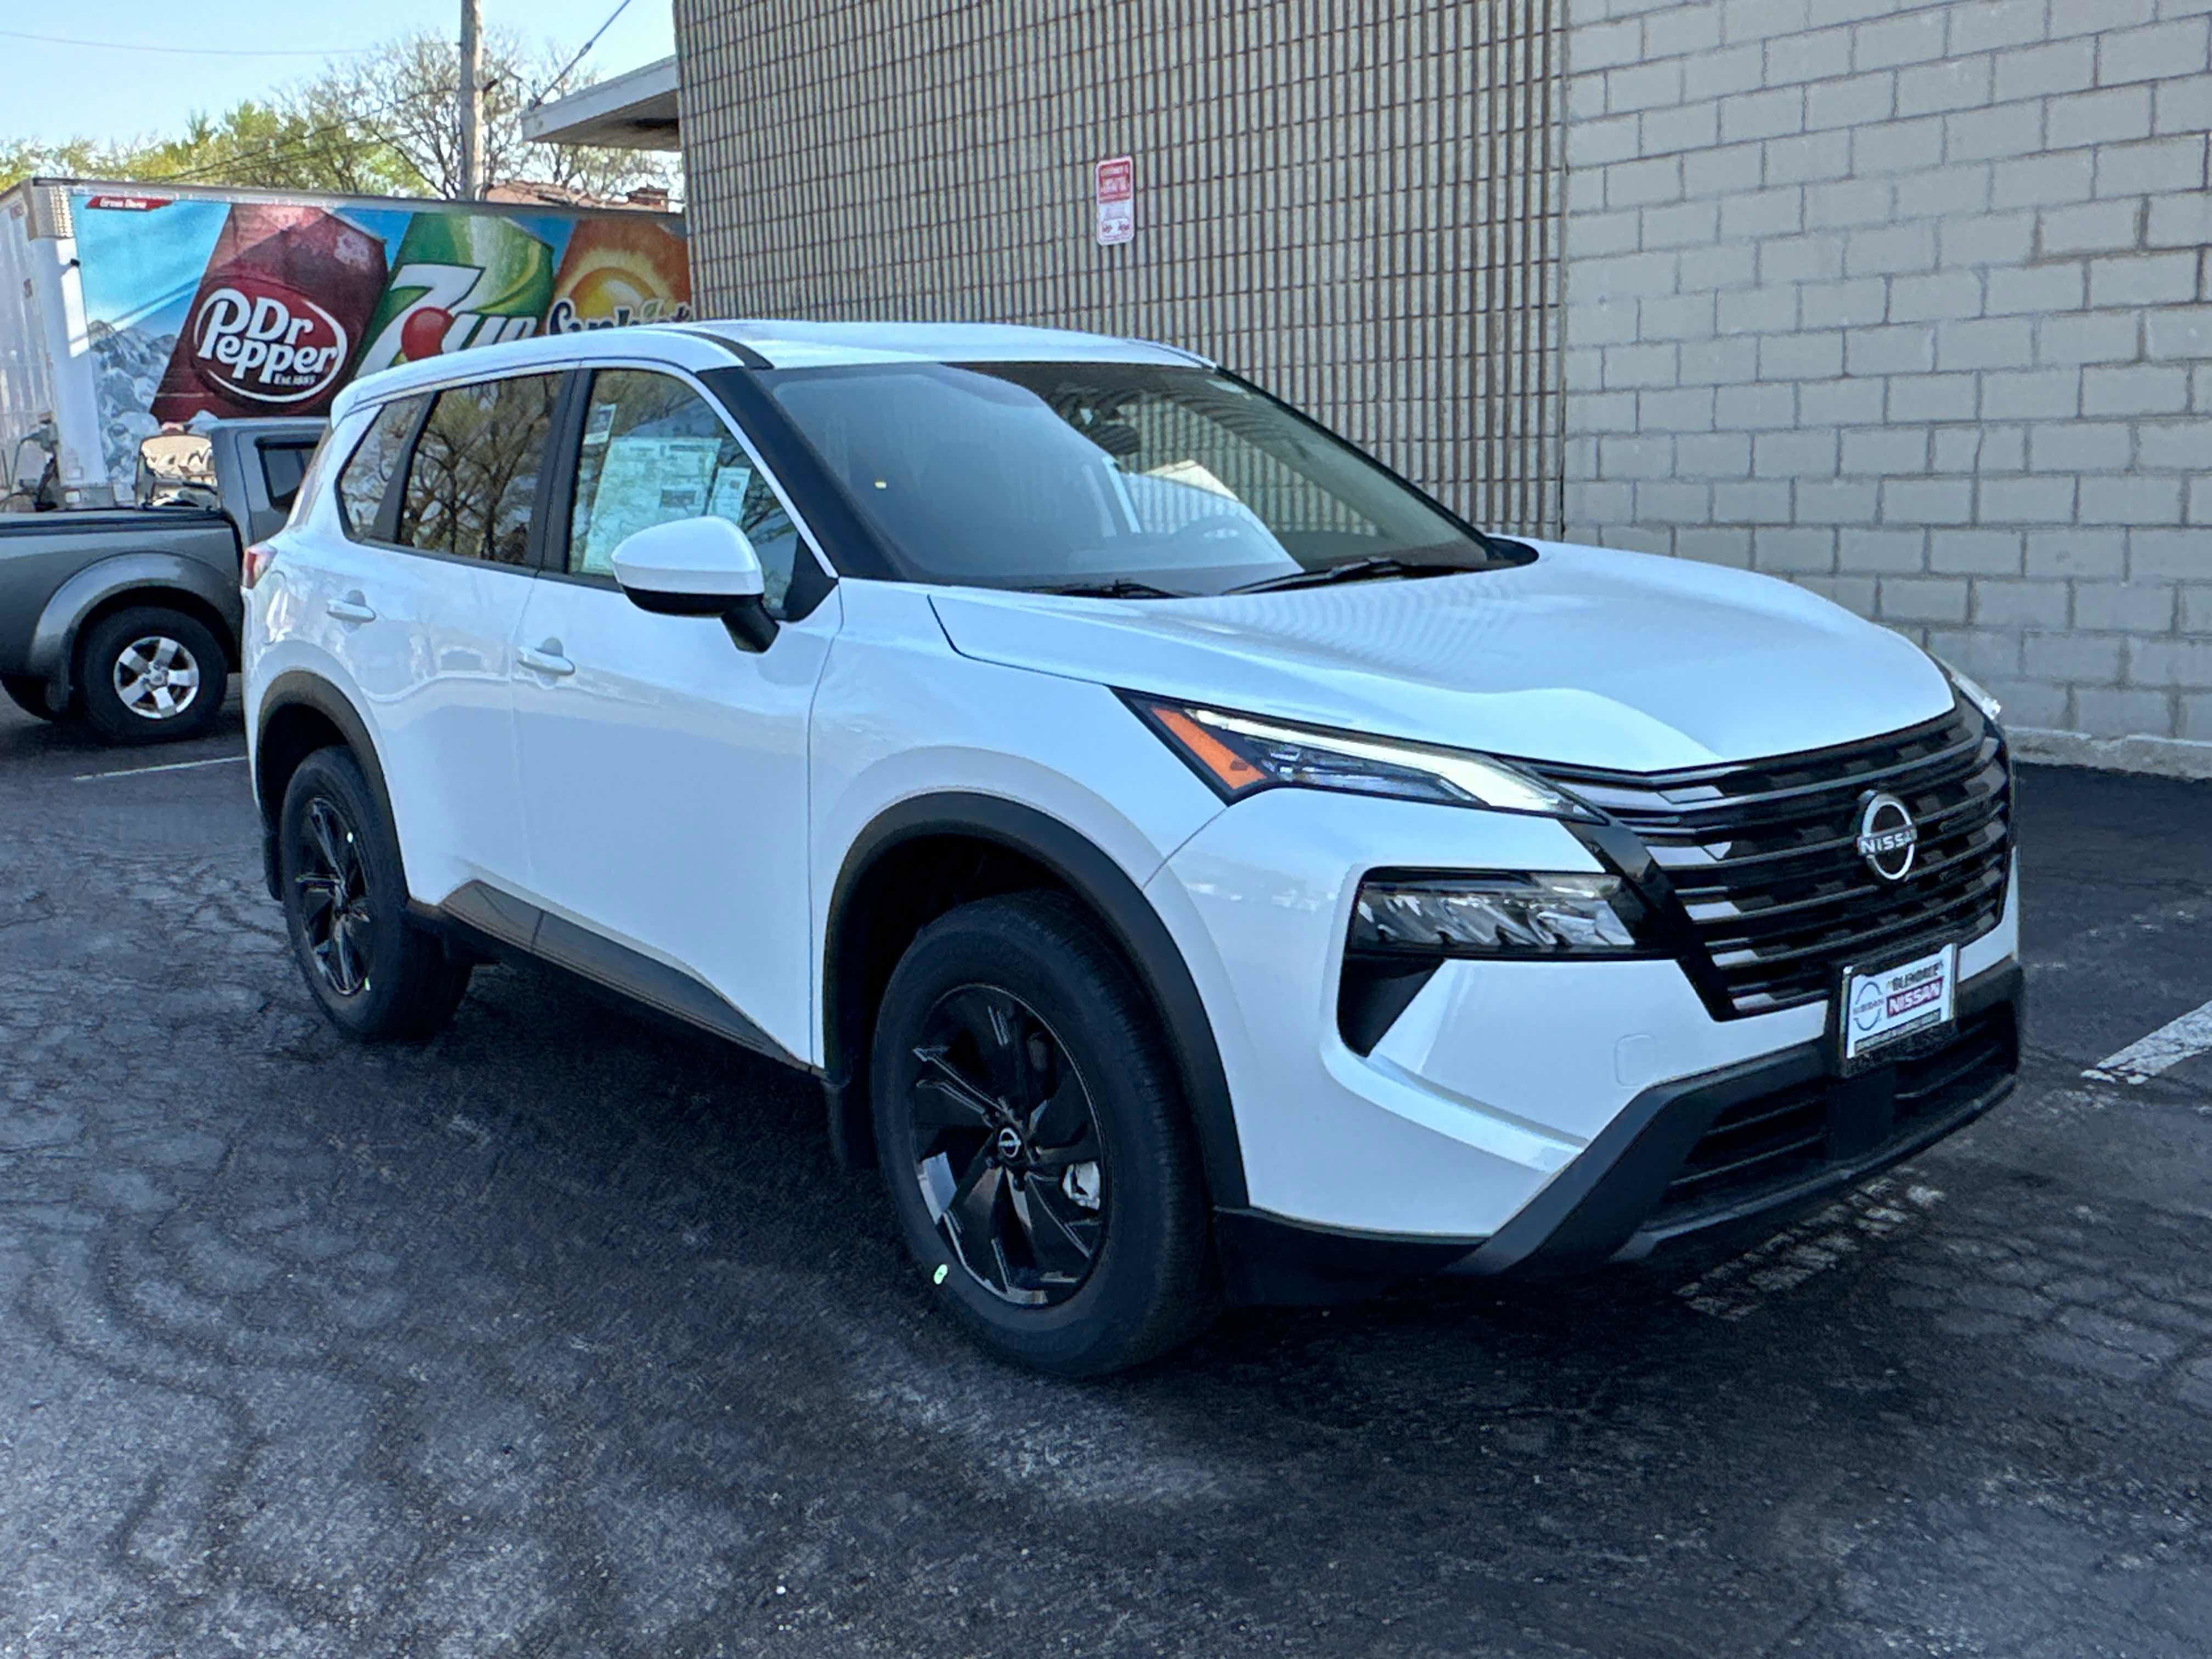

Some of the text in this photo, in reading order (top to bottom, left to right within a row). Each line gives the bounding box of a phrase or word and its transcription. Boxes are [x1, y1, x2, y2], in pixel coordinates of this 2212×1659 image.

[194, 287, 338, 383] Pepper
[246, 296, 314, 344] Dr
[1889, 981, 1941, 1015] NISSAN
